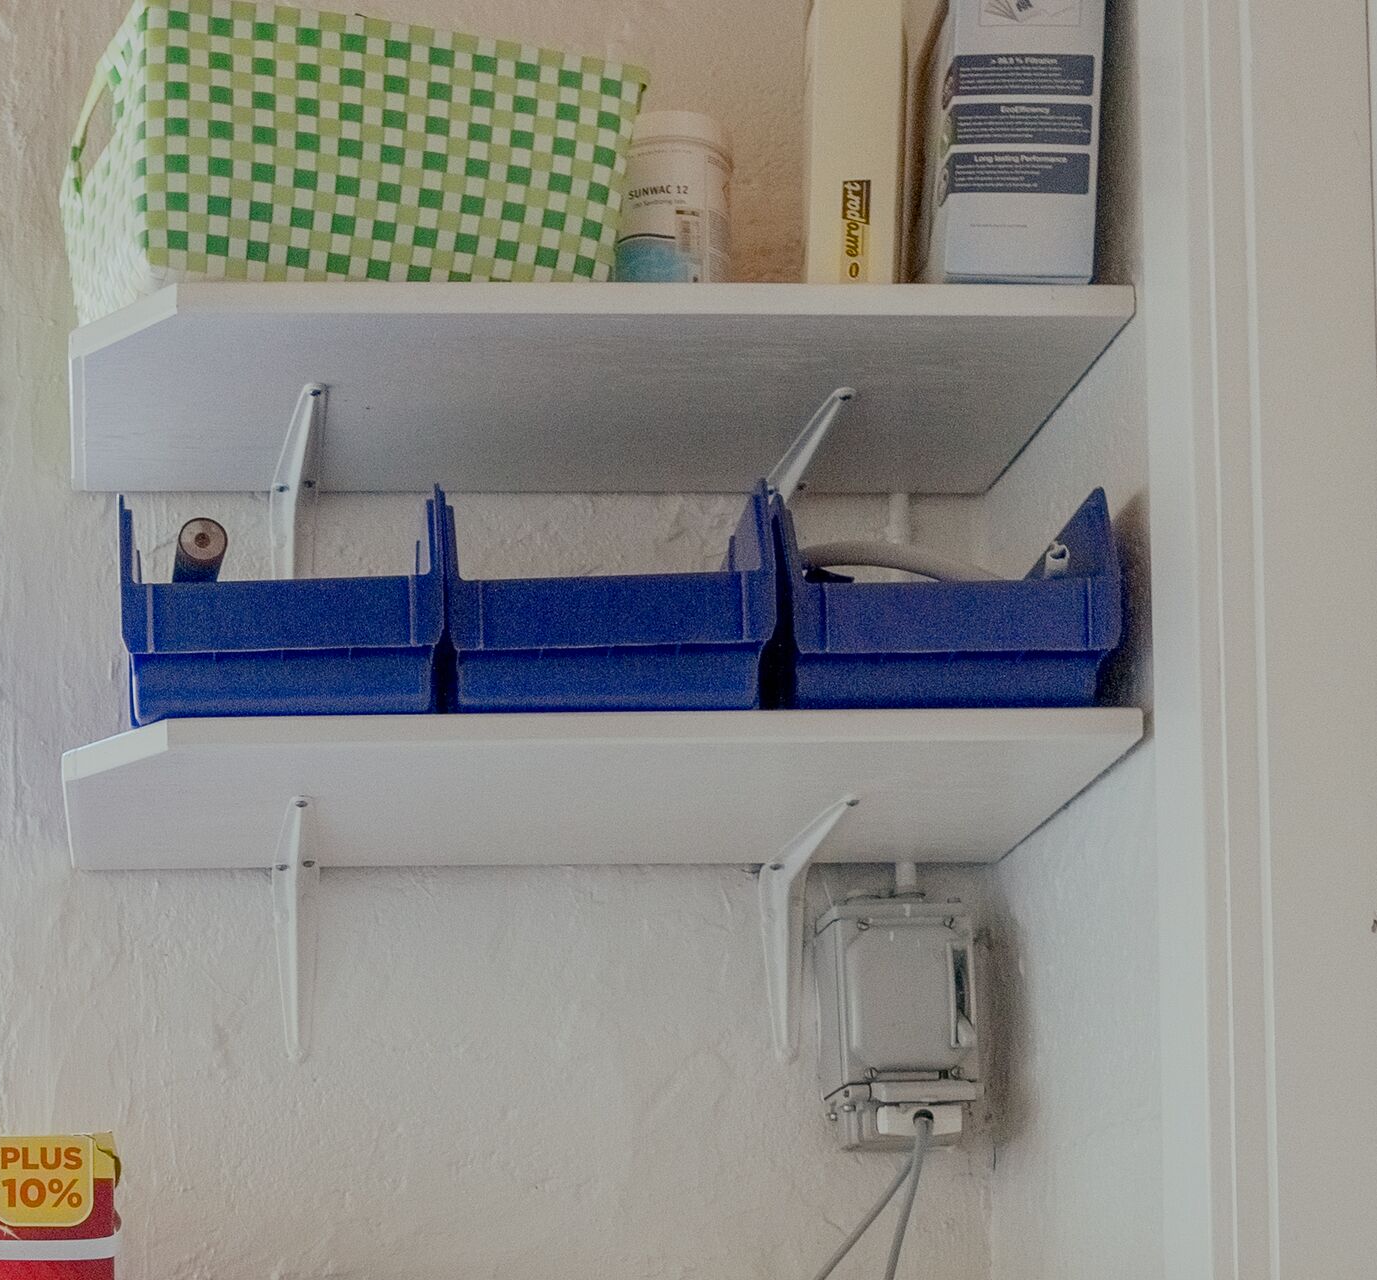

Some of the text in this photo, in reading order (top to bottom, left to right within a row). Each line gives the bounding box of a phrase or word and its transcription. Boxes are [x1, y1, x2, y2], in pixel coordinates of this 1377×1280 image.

[628, 185, 689, 200] SUNWAC 12
[843, 180, 866, 258] europart
[0, 1146, 83, 1171] PLUS
[1, 1178, 83, 1209] 10%
